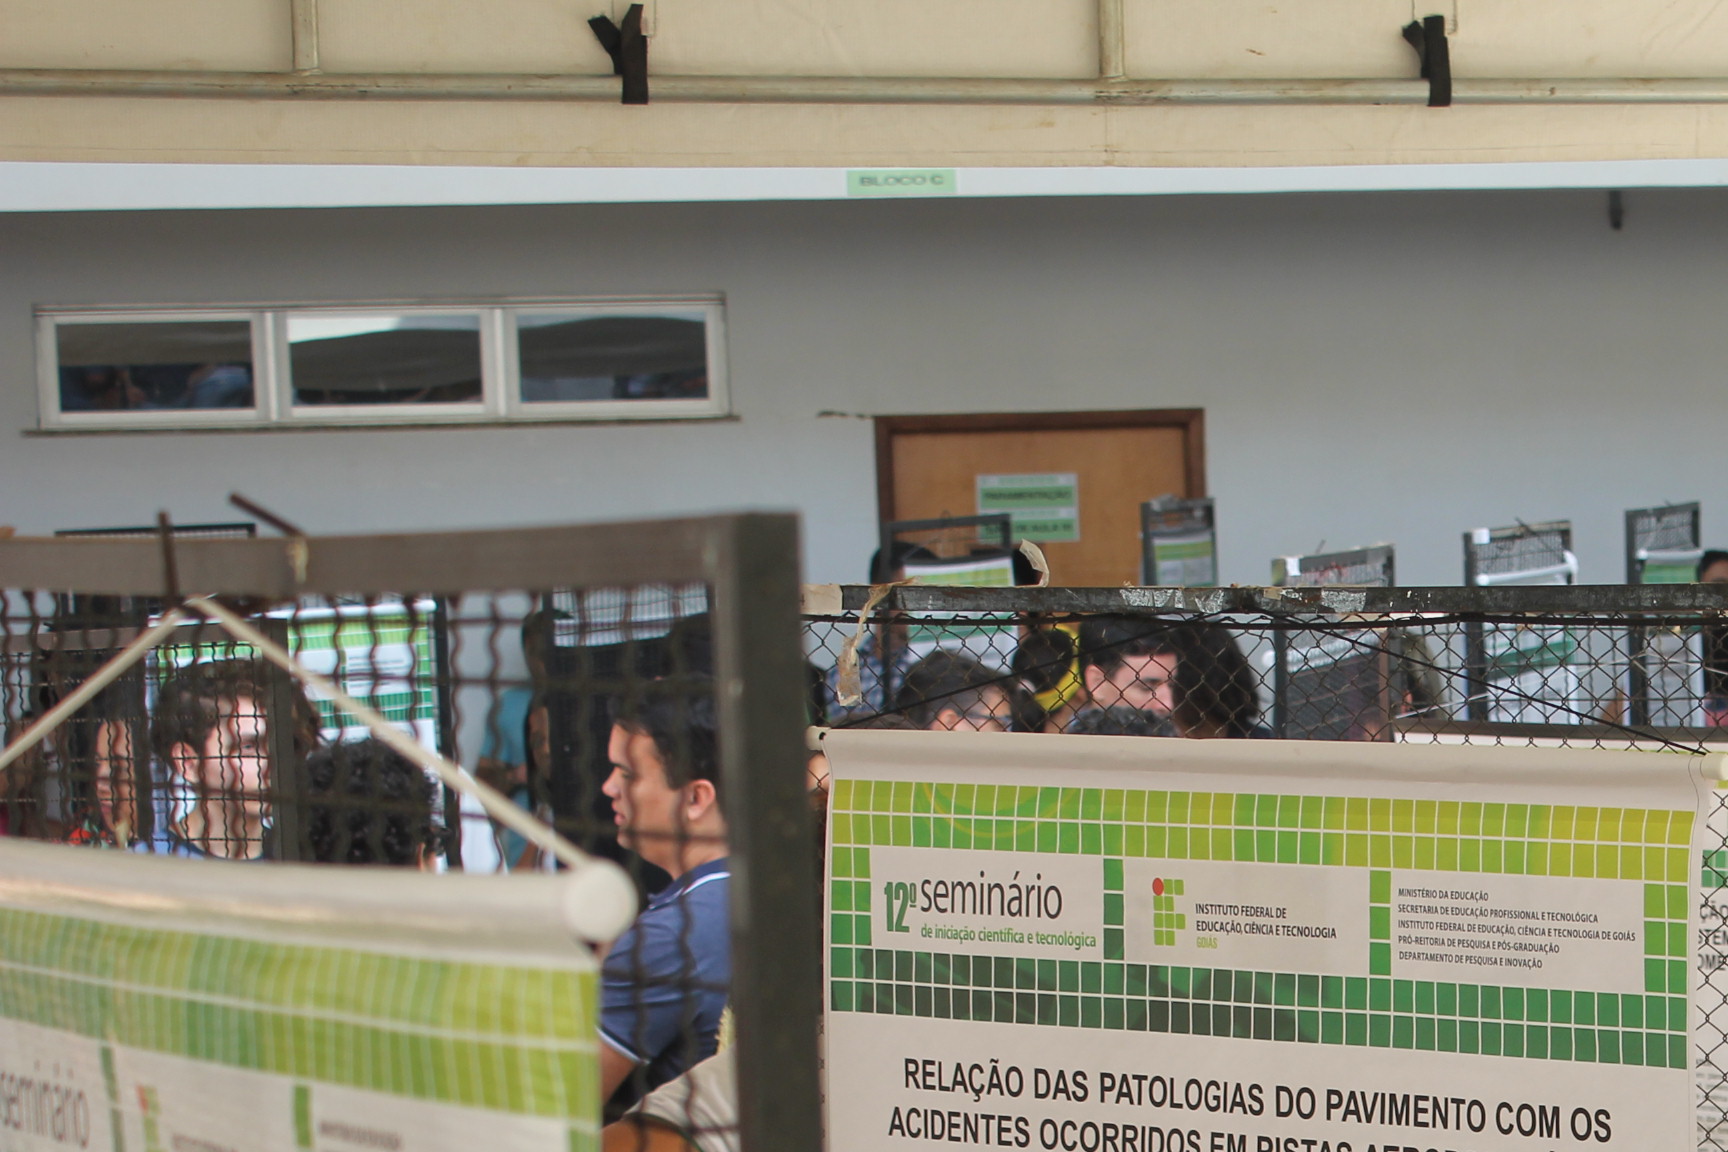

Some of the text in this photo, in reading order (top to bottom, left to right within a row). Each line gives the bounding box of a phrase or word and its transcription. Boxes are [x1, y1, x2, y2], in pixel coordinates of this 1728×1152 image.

[859, 174, 944, 187] BLOCO C
[884, 870, 1063, 933] 12º seminário
[1397, 887, 1488, 903] MINISTÉRIO DA EDUCAÇÃO
[1195, 903, 1286, 919] INSTITUTO FEDERAL DE
[1397, 903, 1598, 923] SECRETARIA DE EDUCAÇÃO PROFISSIONAL E TECNOLÓGICA
[920, 923, 1096, 951] de iniciação científica e tecnológica
[1195, 919, 1336, 939] EDUCAÇÃO, CIÊNCIA E TECNOLOGIA
[1397, 919, 1636, 942] INSTITUTO FEDERAL DE EDUCAÇÃO, CIÊNCIA E TECNOLOGIA DE GOIÁS
[1195, 934, 1218, 949] GOIÁS
[1397, 933, 1560, 955] PRÓ-REITORIA DE PESQUISA E PÓS-GRADUAÇÃO
[1398, 950, 1543, 970] DEPARTAMENTO DE PESQUISA E INOVAÇÃO
[904, 1057, 1611, 1143] RELAÇÃO DAS PATOLOGIAS DO PAVIMENTO COM OS
[888, 1106, 1030, 1148] ACIDENTES
